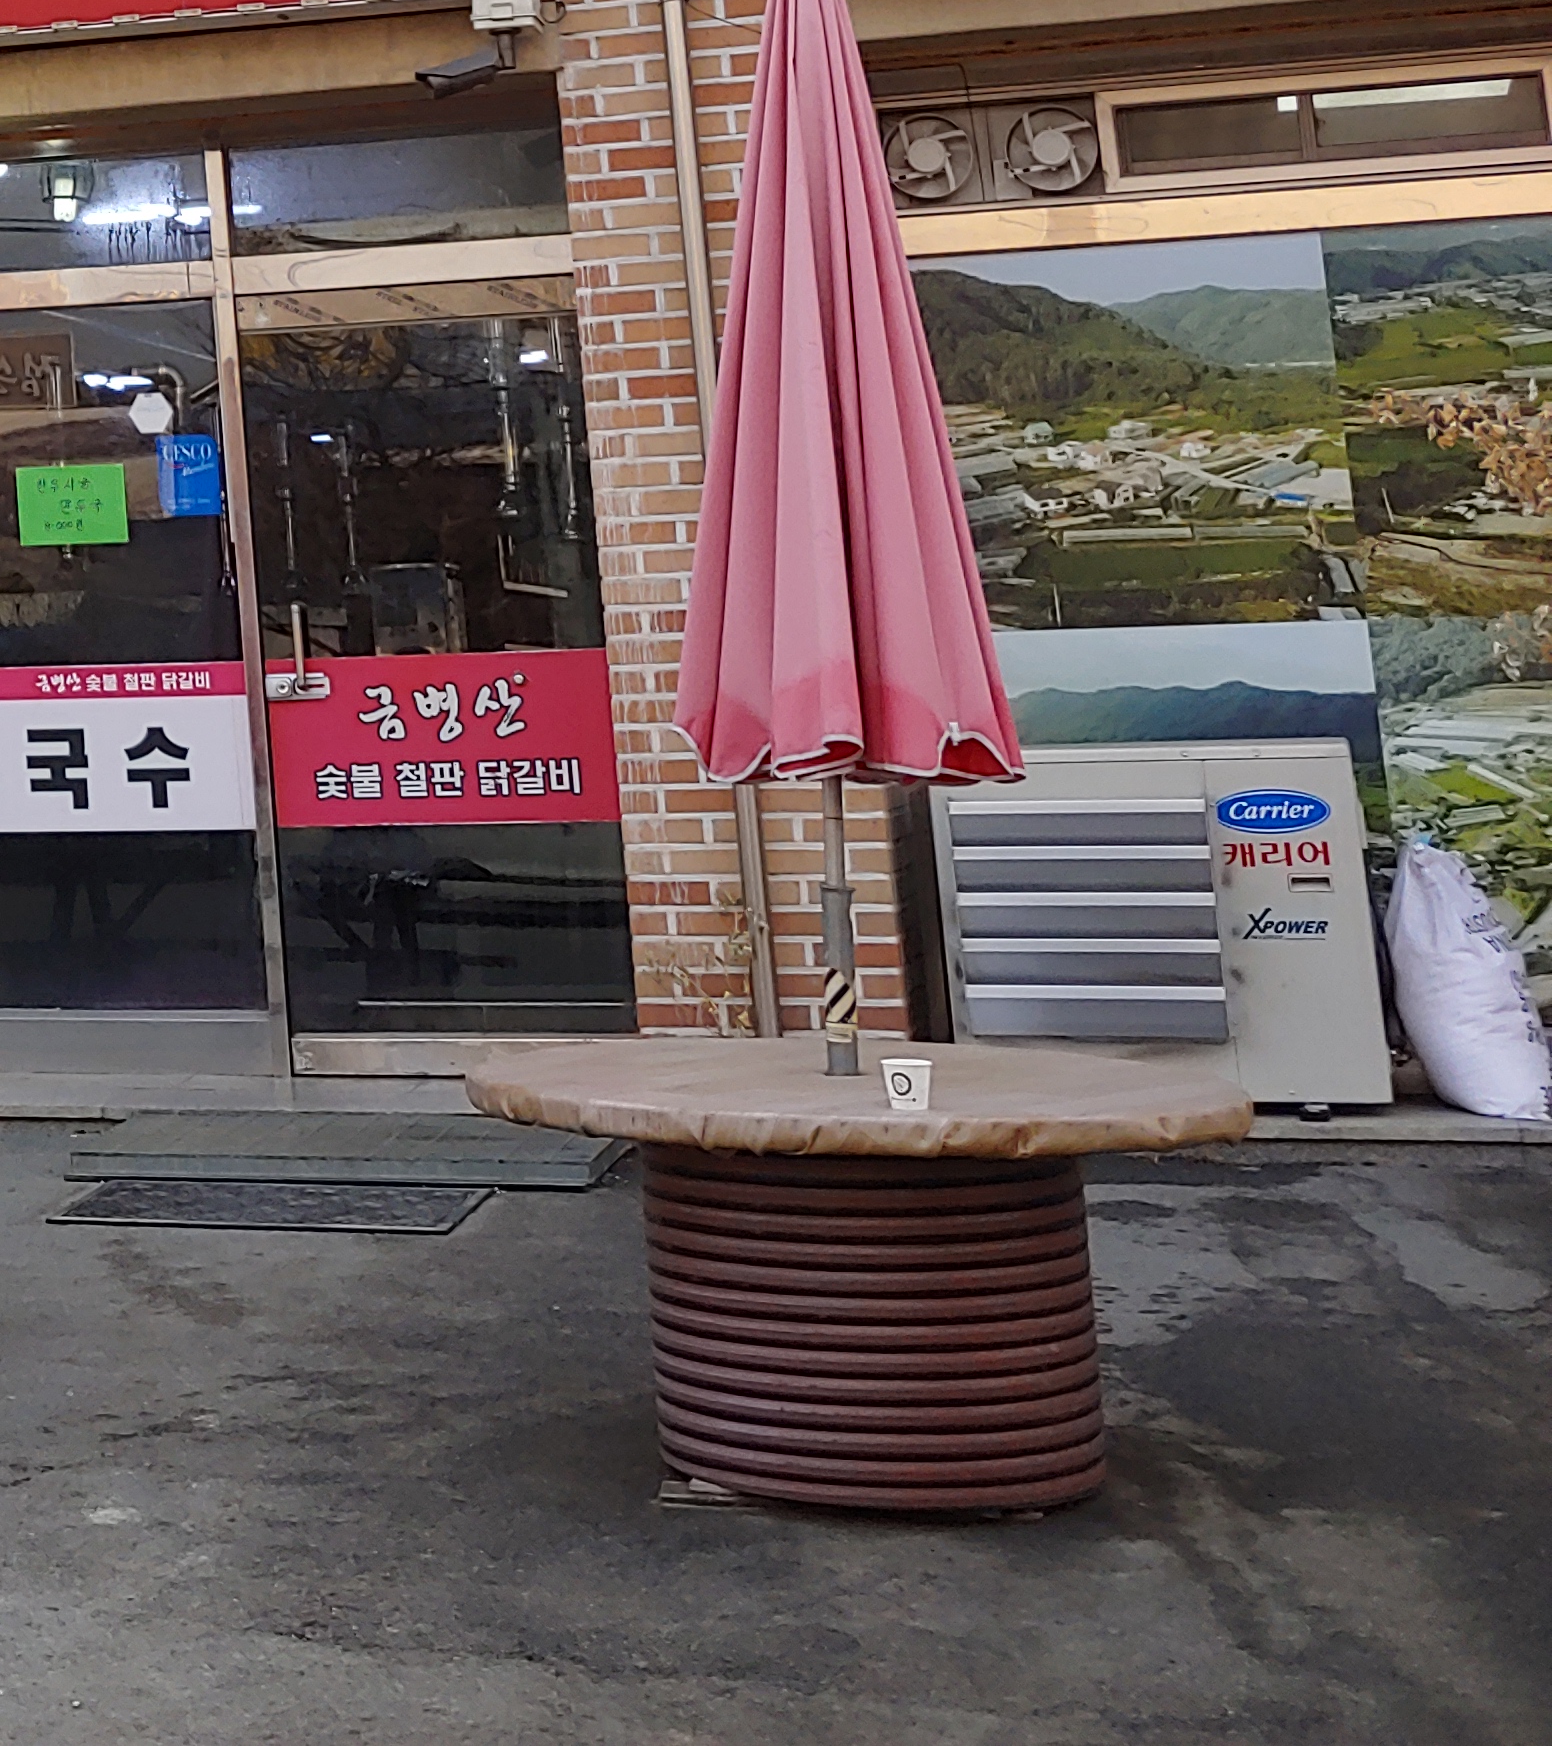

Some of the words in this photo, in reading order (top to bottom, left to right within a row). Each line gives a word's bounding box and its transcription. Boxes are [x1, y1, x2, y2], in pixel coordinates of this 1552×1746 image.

[34, 673, 82, 693] 금병산
[85, 673, 118, 693] 숯불
[123, 672, 157, 692] 철판
[161, 670, 211, 691] 닭갈비
[357, 676, 528, 743] 금병산
[316, 762, 383, 800] 숯불
[395, 760, 466, 798] 철판
[478, 757, 583, 798] 닭갈비
[1228, 800, 1315, 821] Carrier
[1222, 840, 1331, 869] 캐리어
[1242, 907, 1329, 940] XPOWER
